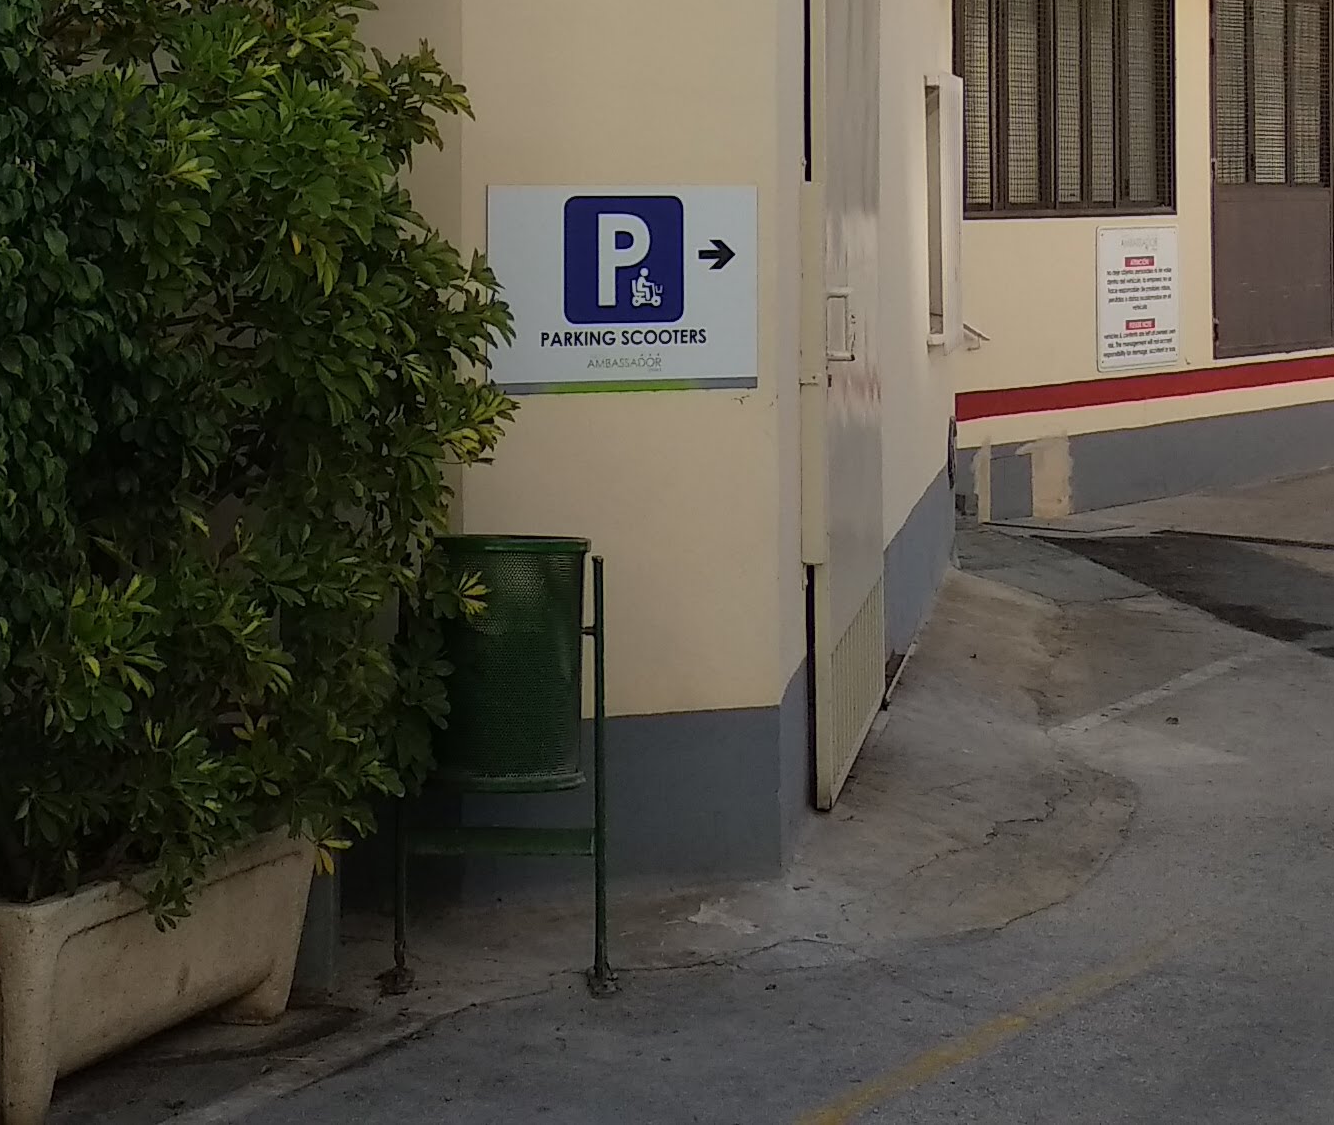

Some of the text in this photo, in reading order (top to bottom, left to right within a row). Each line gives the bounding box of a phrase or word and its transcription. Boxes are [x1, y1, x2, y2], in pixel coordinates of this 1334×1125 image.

[597, 213, 651, 307] P
[540, 328, 707, 348] PARKING SCOOTERS
[587, 356, 662, 369] AMBASSADOR
